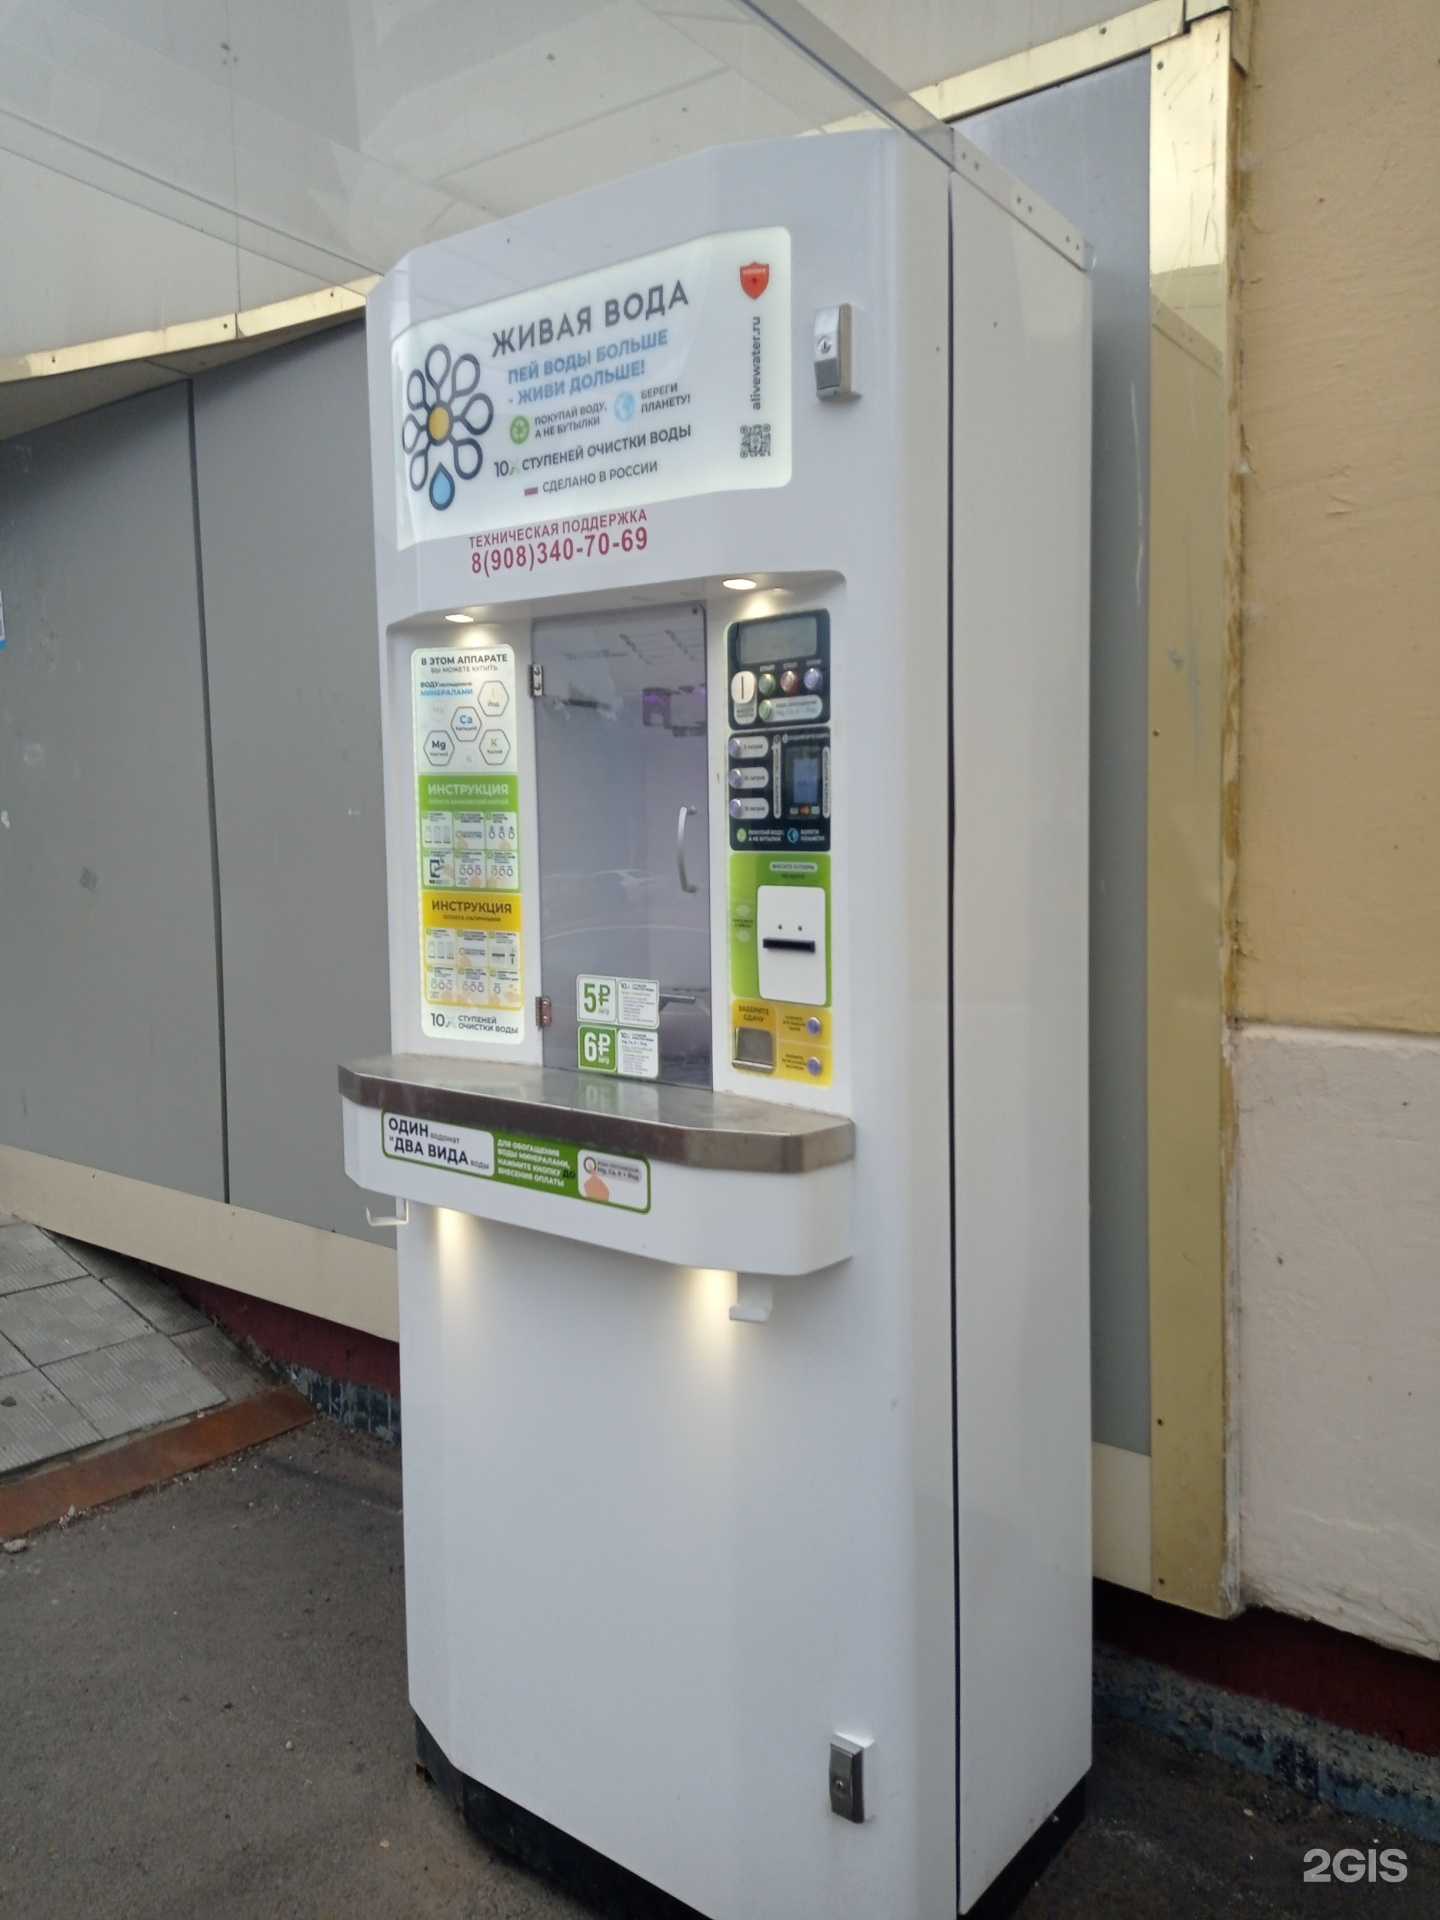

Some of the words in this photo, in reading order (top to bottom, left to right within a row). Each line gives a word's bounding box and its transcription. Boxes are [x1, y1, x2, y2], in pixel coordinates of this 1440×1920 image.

[492, 305, 592, 358] ЖИВАЯ
[604, 280, 689, 328] ВОДА
[508, 360, 540, 385] ПЕЙ
[544, 351, 591, 377] ВОДЫ
[596, 329, 669, 364] БОЛЬШЕ
[750, 316, 761, 411] alivewater.ru
[518, 379, 566, 406] ЖИВИ
[569, 359, 646, 396] ДОЛЬШЕ!
[640, 382, 678, 400] БЕРЕГИ
[640, 394, 691, 414] ПЛАНЕТУ!
[534, 407, 578, 426] ПОКУПАЙ
[535, 430, 542, 440] А
[544, 426, 556, 438] НЕ
[557, 416, 600, 434] БУТЫЛКИ
[522, 445, 584, 471] СТУПЕНЕЙ
[587, 433, 646, 458] ОЧИСТКИ
[650, 424, 692, 445] ВОДЫ
[542, 472, 596, 494] СДЕЛАНО
[599, 470, 607, 482] В
[610, 461, 658, 482] РОССИИ
[469, 522, 559, 550] ТЕХНИЧЕСКАЯ
[562, 508, 648, 534] ПОДДЕРЖКА
[472, 526, 648, 577] 8(908)340-70-69
[421, 657, 427, 666] В
[430, 656, 455, 666] ЭТОМ
[458, 653, 508, 664] АППАРАТЕ
[432, 740, 446, 751] Mg
[428, 783, 509, 796] ИНСТРУКЦИЯ
[432, 900, 512, 915] ИНСТРУКЦИЯ
[430, 1012, 446, 1028] 10
[458, 1014, 497, 1024] СТУПЕНЕЙ
[458, 1022, 494, 1032] ОЧИСТКИ
[495, 1026, 519, 1034] ВОДЫ
[388, 1118, 428, 1138] ОДИН
[394, 1137, 424, 1156] ДВА
[428, 1143, 469, 1165] ВИДА
